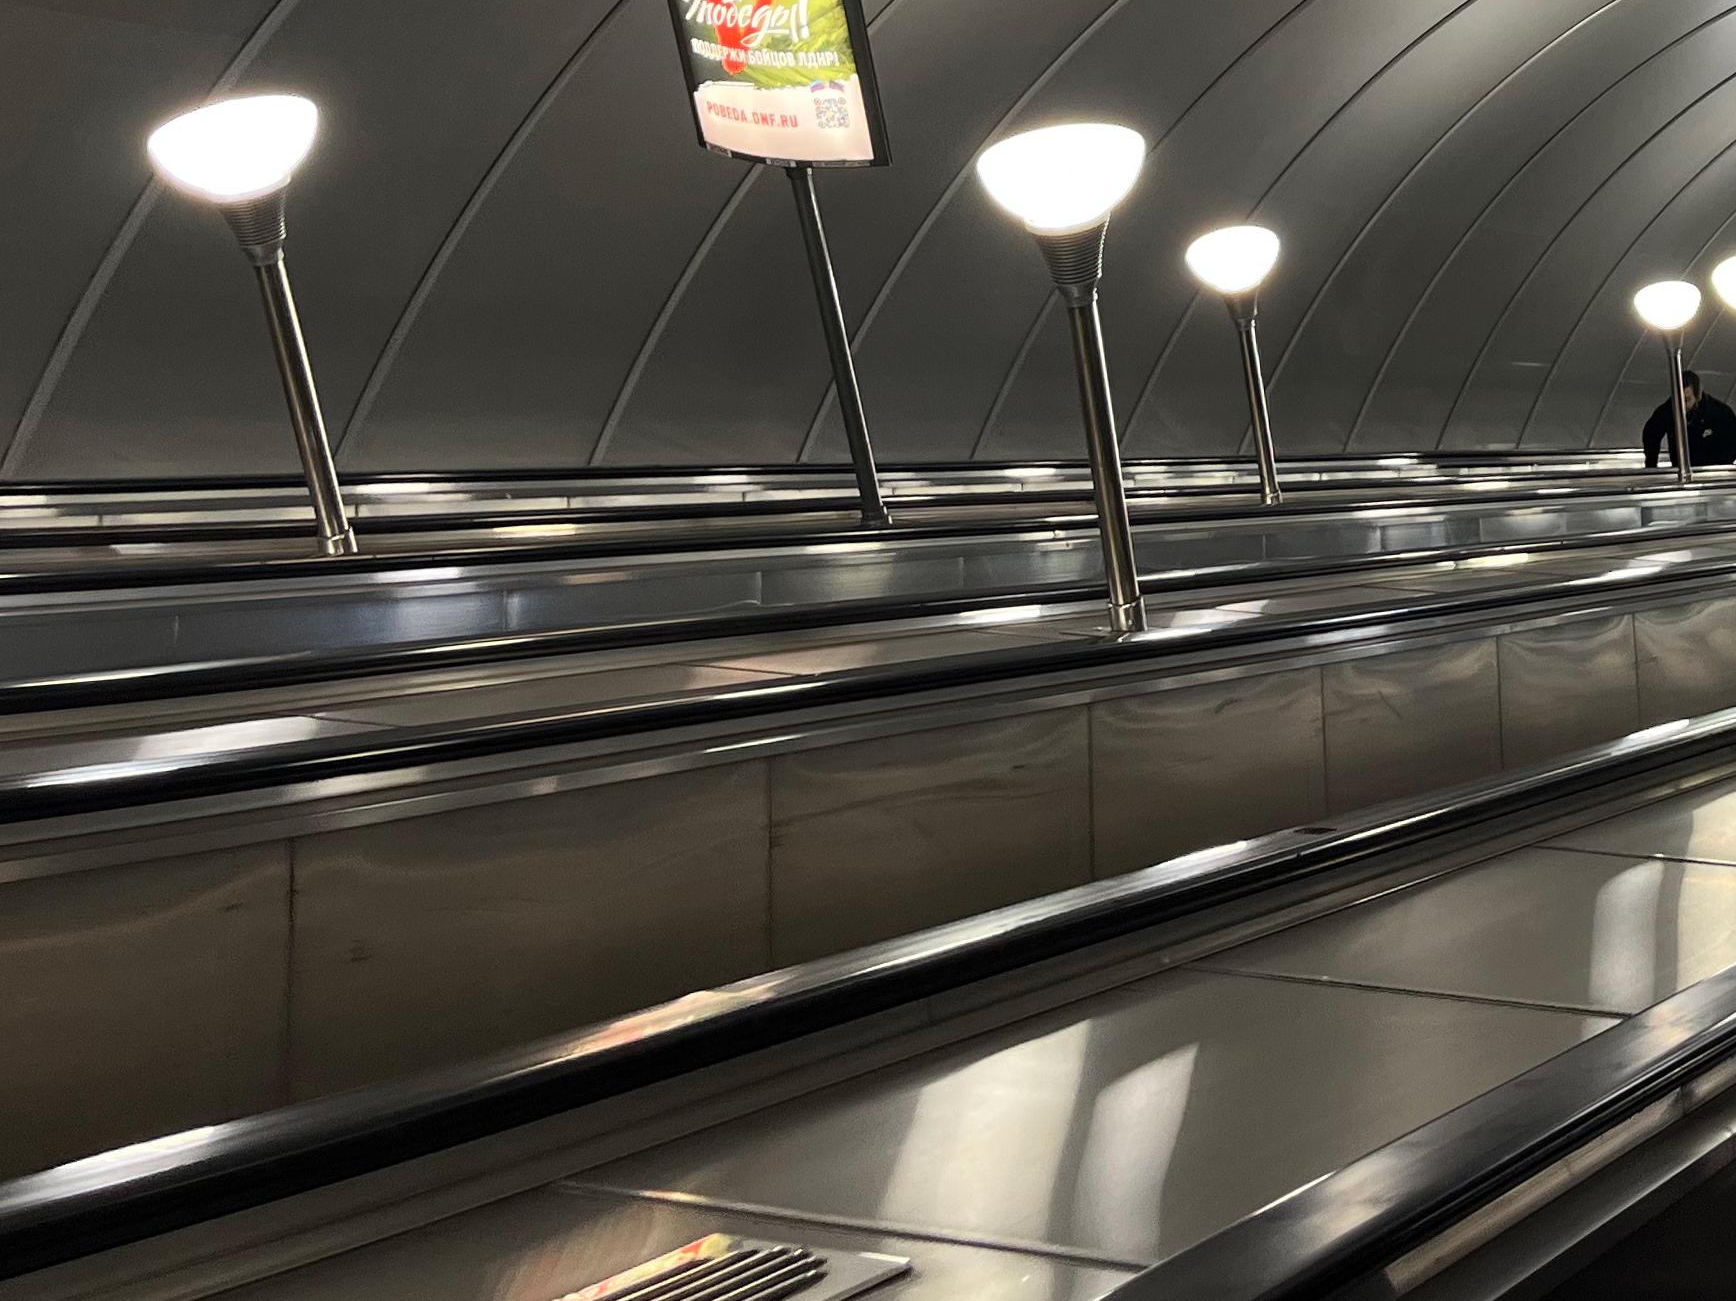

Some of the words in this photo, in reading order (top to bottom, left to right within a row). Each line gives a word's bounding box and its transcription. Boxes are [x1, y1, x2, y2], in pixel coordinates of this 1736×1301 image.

[691, 37, 746, 62] ПОДДЕРЖИ
[746, 48, 796, 68] БОЙЦОВ
[798, 50, 840, 70] ЛДНР!
